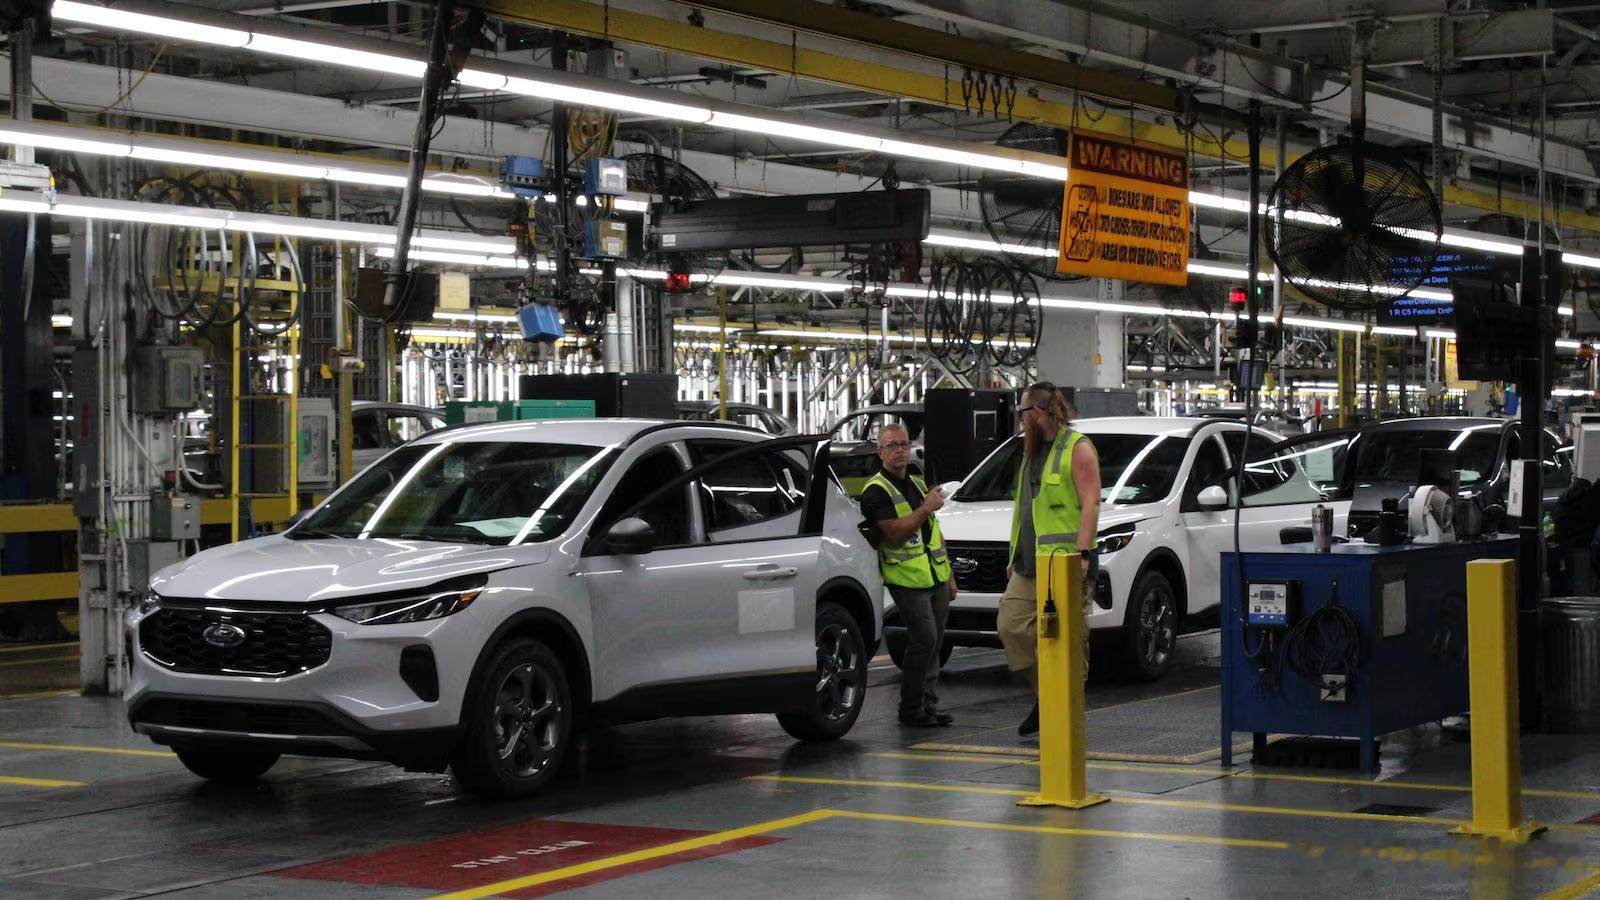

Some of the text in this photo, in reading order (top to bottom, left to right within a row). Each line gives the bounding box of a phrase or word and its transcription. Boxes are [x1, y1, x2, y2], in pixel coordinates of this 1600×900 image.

[1078, 140, 1184, 184] WARNING
[1127, 190, 1141, 210] ARE
[1142, 193, 1155, 212] NOT
[1155, 196, 1181, 217] ALLOWED
[1119, 245, 1128, 262] OR
[1412, 307, 1437, 315] Fender
